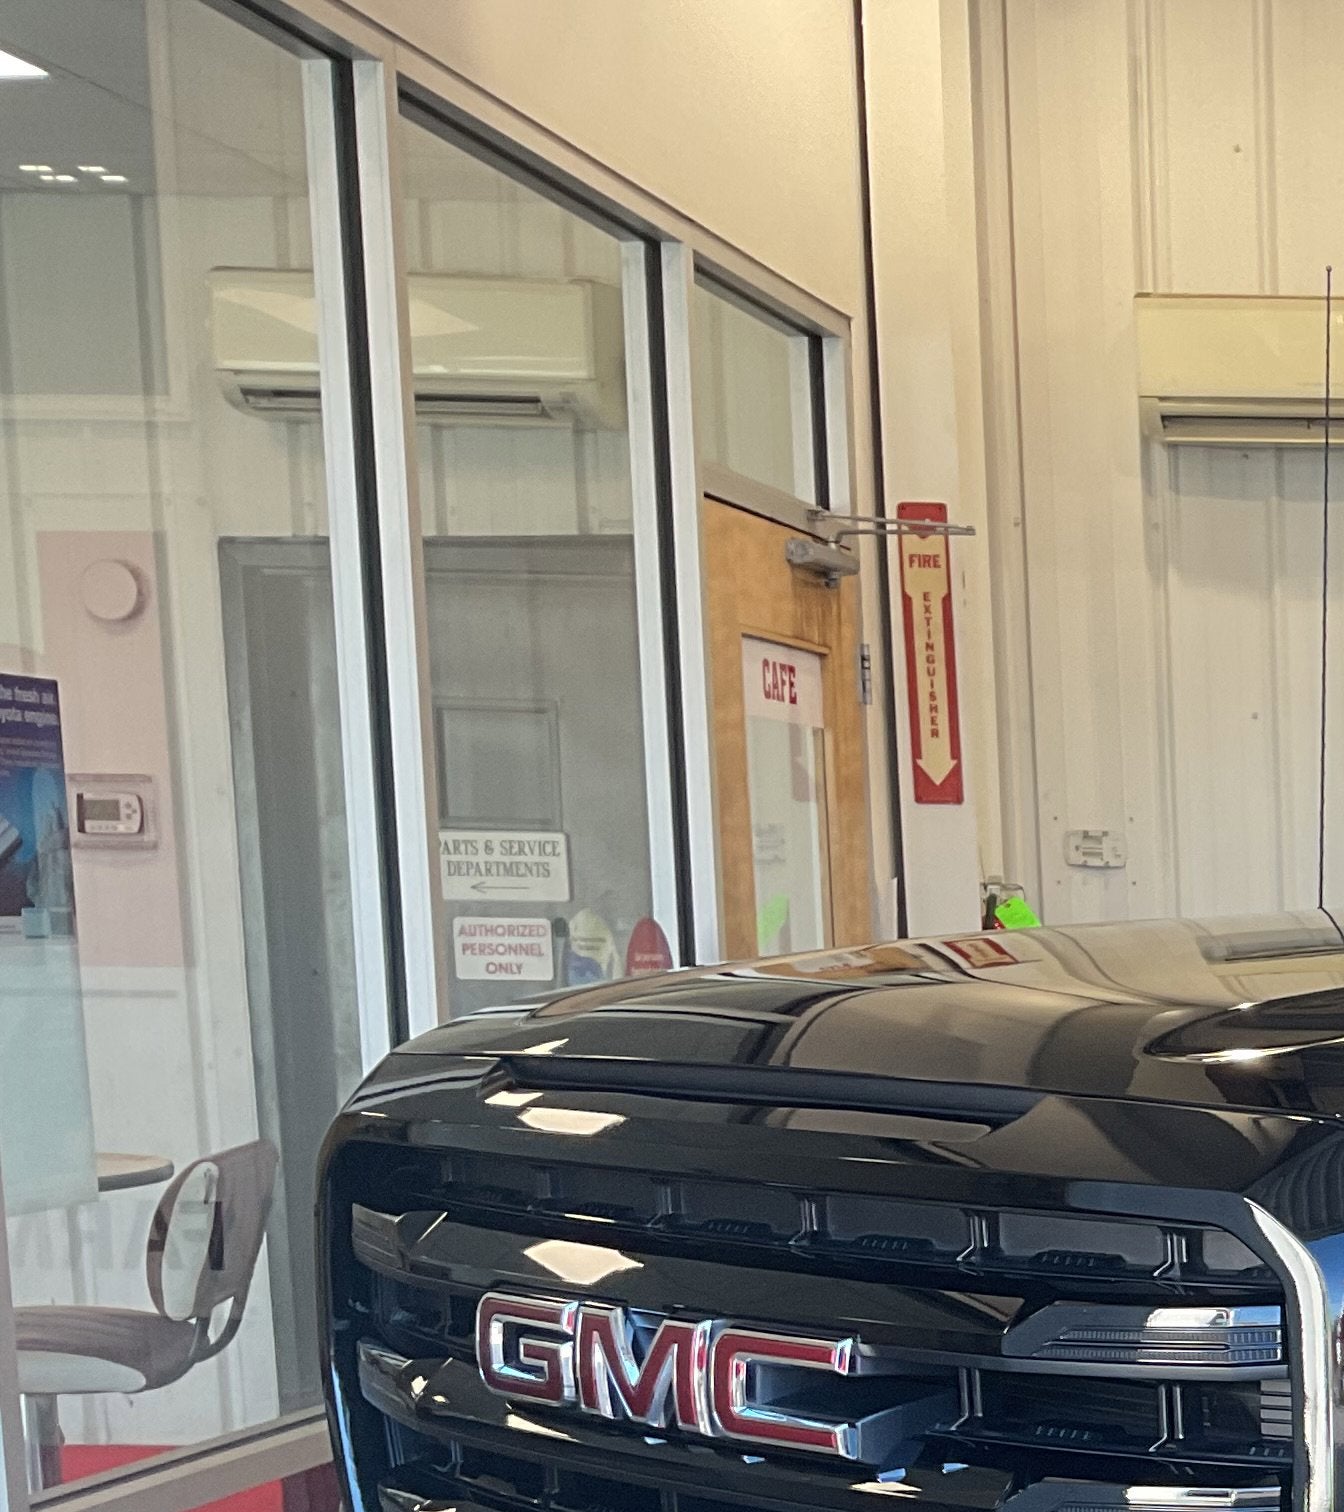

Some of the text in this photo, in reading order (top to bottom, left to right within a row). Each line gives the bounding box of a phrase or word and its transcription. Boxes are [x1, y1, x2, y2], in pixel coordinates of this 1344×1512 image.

[908, 553, 941, 569] FIRE
[922, 591, 940, 739] EXTINGUISHER
[762, 658, 797, 705] CAFE
[439, 838, 561, 857] ARTS & SERVICE
[446, 860, 551, 878] DEPARTMENTS
[458, 924, 547, 938] AUTHORIZED
[461, 943, 545, 957] PERSONNEL
[485, 961, 524, 975] ONLY
[476, 1291, 863, 1460] GMC
